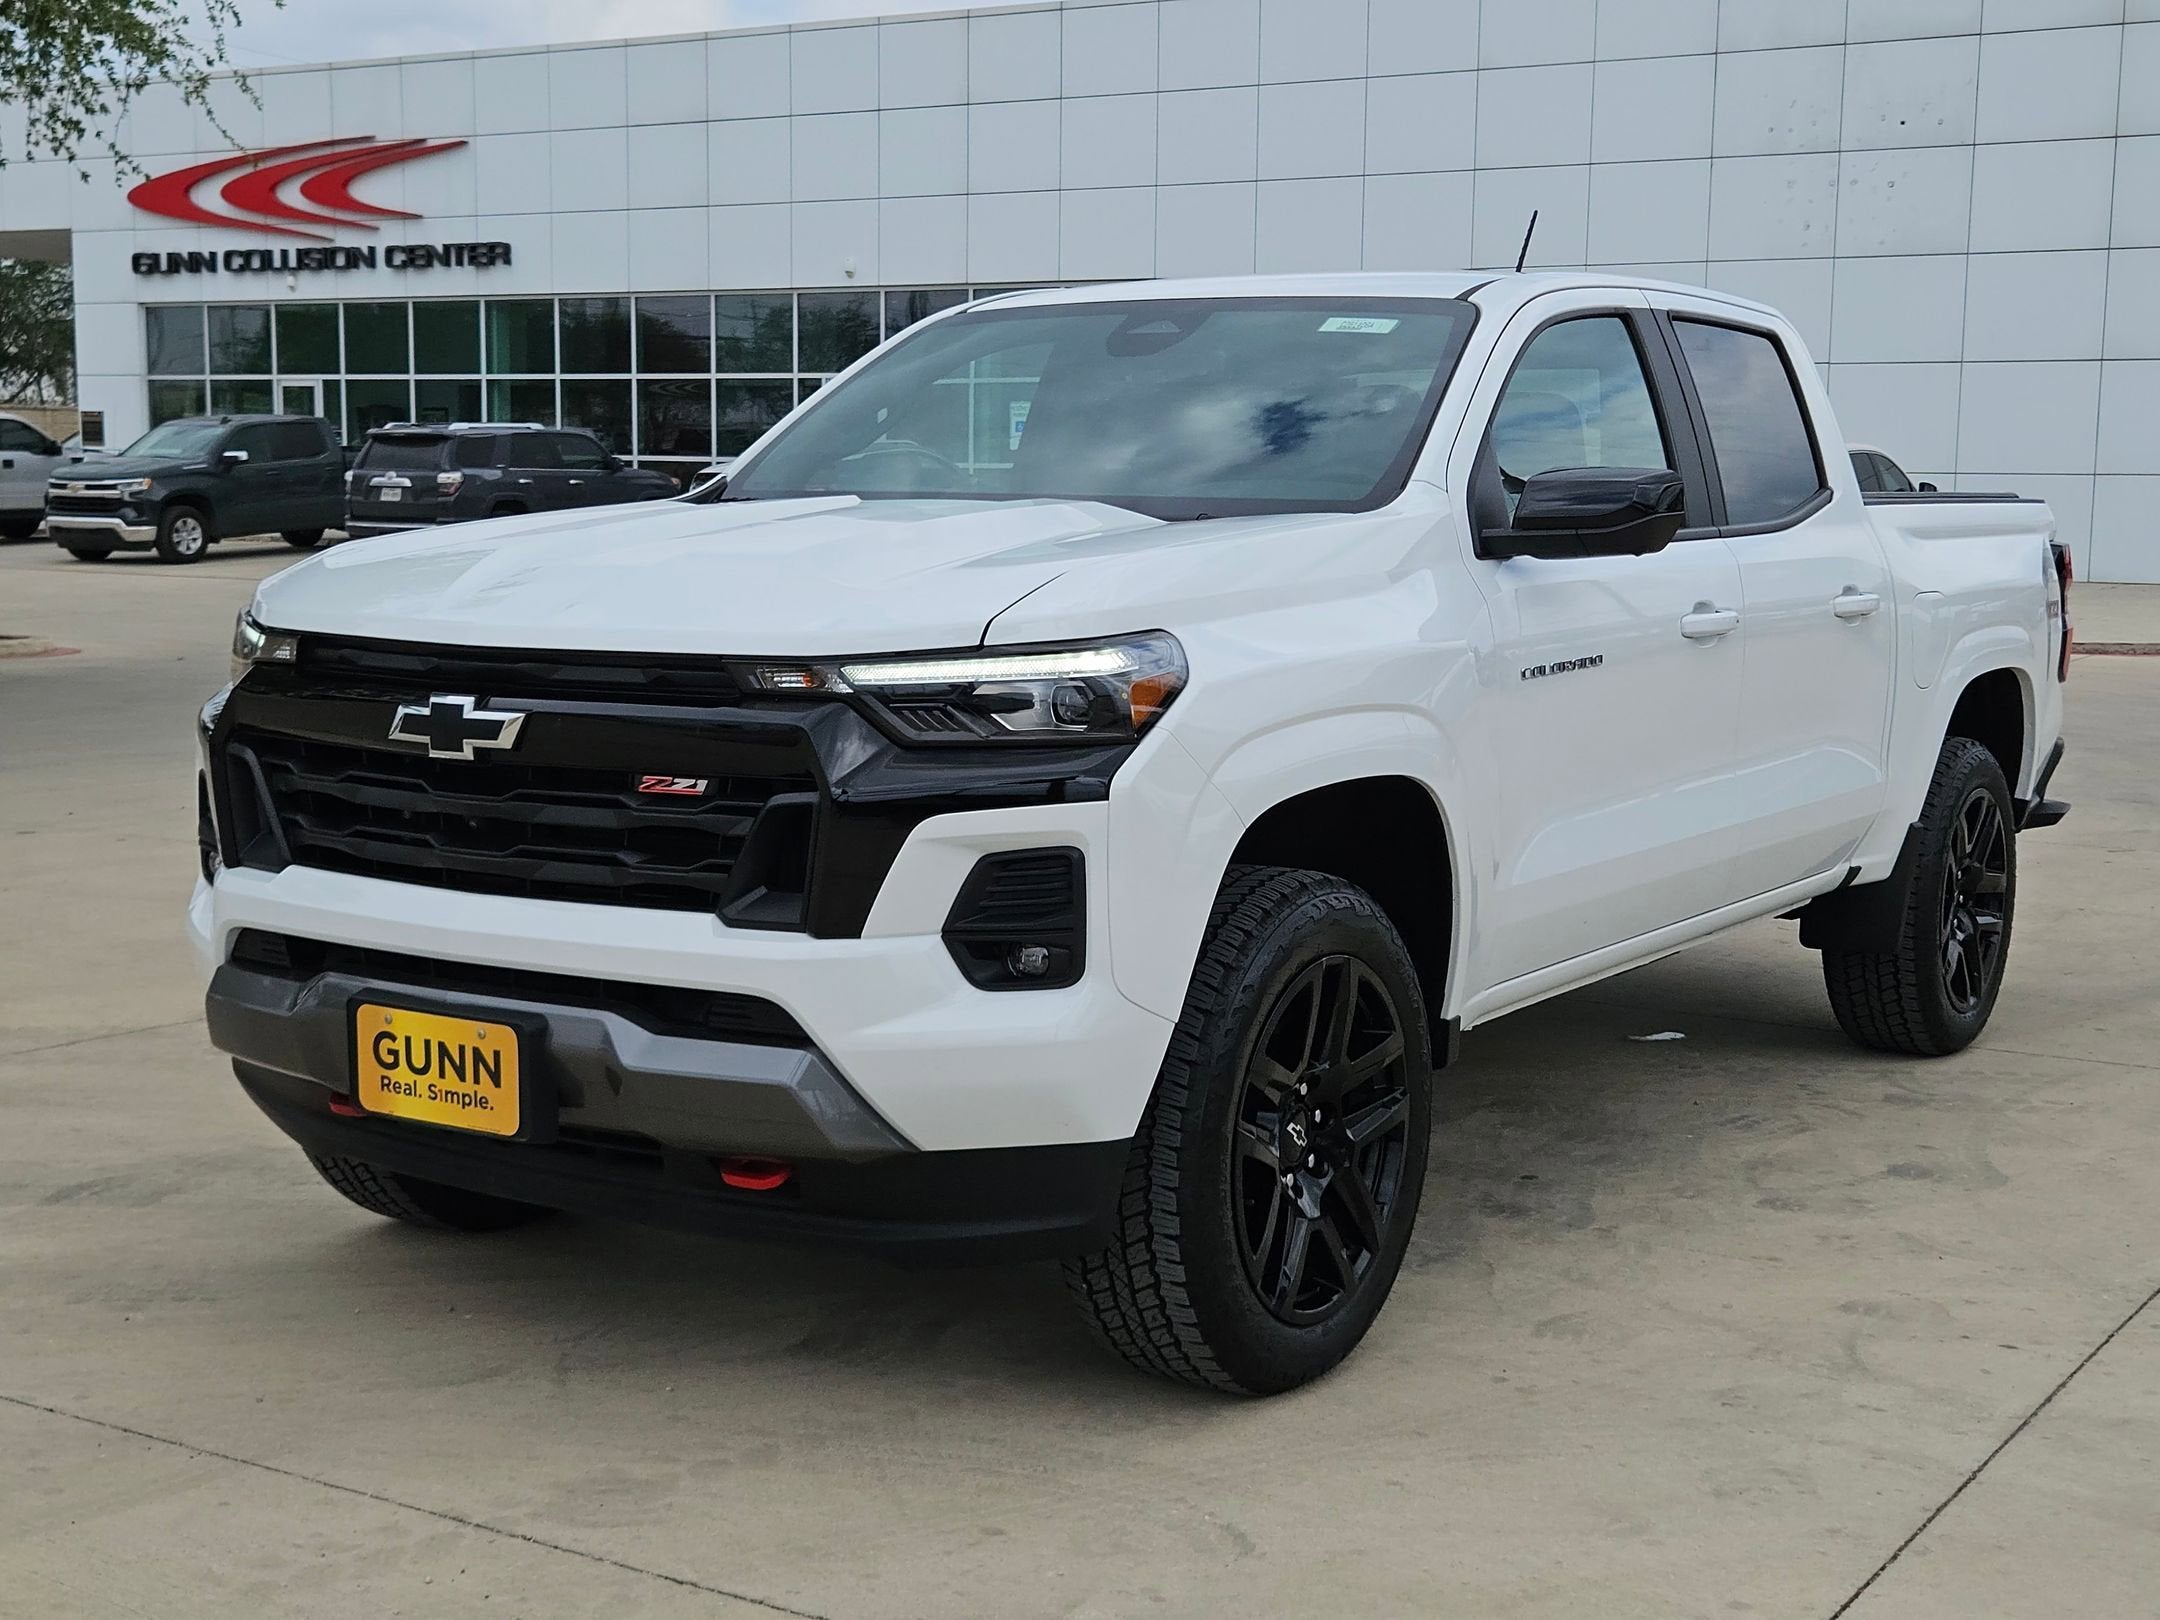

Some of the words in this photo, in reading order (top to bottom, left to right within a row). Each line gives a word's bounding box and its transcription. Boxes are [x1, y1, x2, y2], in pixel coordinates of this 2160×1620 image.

[132, 252, 217, 274] GUNN
[223, 246, 376, 272] COLLISION
[385, 242, 512, 269] CENTER
[1520, 654, 1604, 681] COLORADO
[638, 775, 708, 795] Z71
[372, 1030, 502, 1088] GUNN
[380, 1075, 422, 1098] Real.
